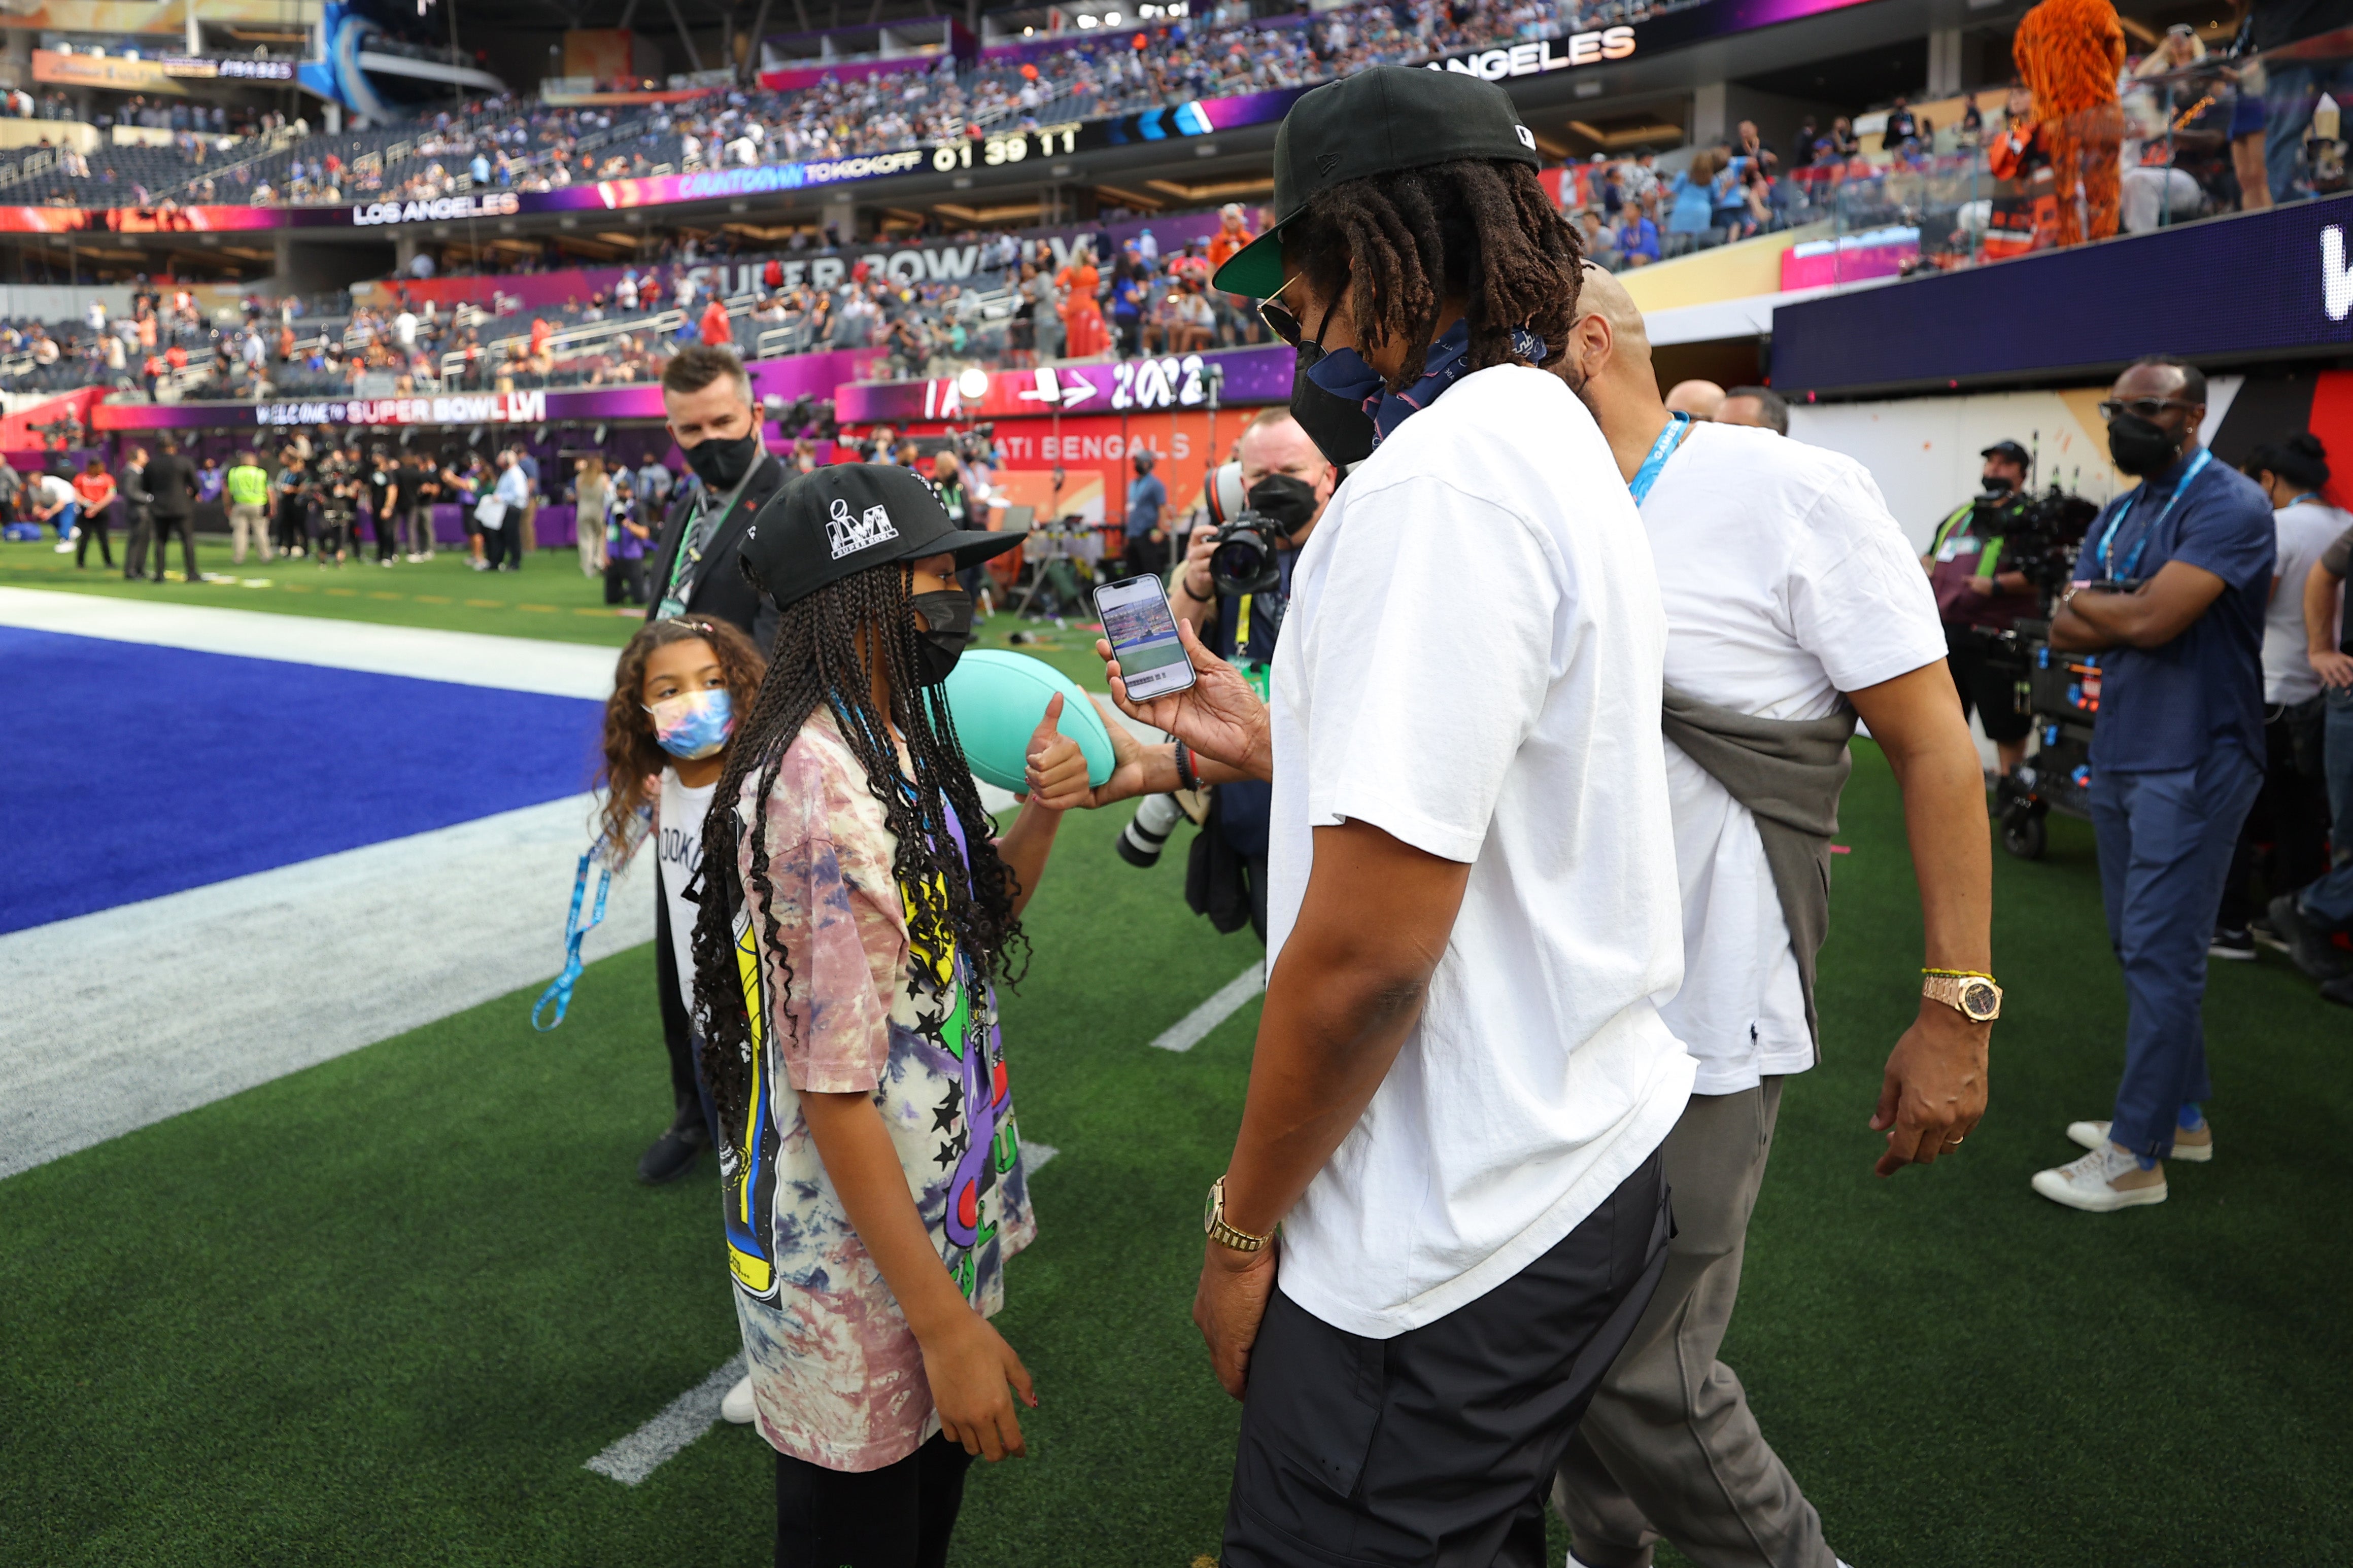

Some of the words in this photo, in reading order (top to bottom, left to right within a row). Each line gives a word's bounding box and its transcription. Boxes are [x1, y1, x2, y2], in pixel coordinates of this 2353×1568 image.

[1426, 26, 1636, 81] NGELES
[679, 162, 805, 198] COUNTDOWN
[933, 145, 972, 172] 01
[984, 137, 1028, 166] 39
[1040, 129, 1075, 157] 11
[354, 202, 402, 226] LOS
[401, 193, 520, 222] ANGELES
[255, 402, 329, 426] WELCOME
[330, 403, 346, 422] TO
[347, 398, 430, 425] SUPER
[432, 396, 507, 423] BOWL
[507, 390, 547, 423] LVI
[1040, 432, 1191, 461] BENGALS
[838, 541, 867, 555] SUPER
[869, 533, 894, 545] BOWL
